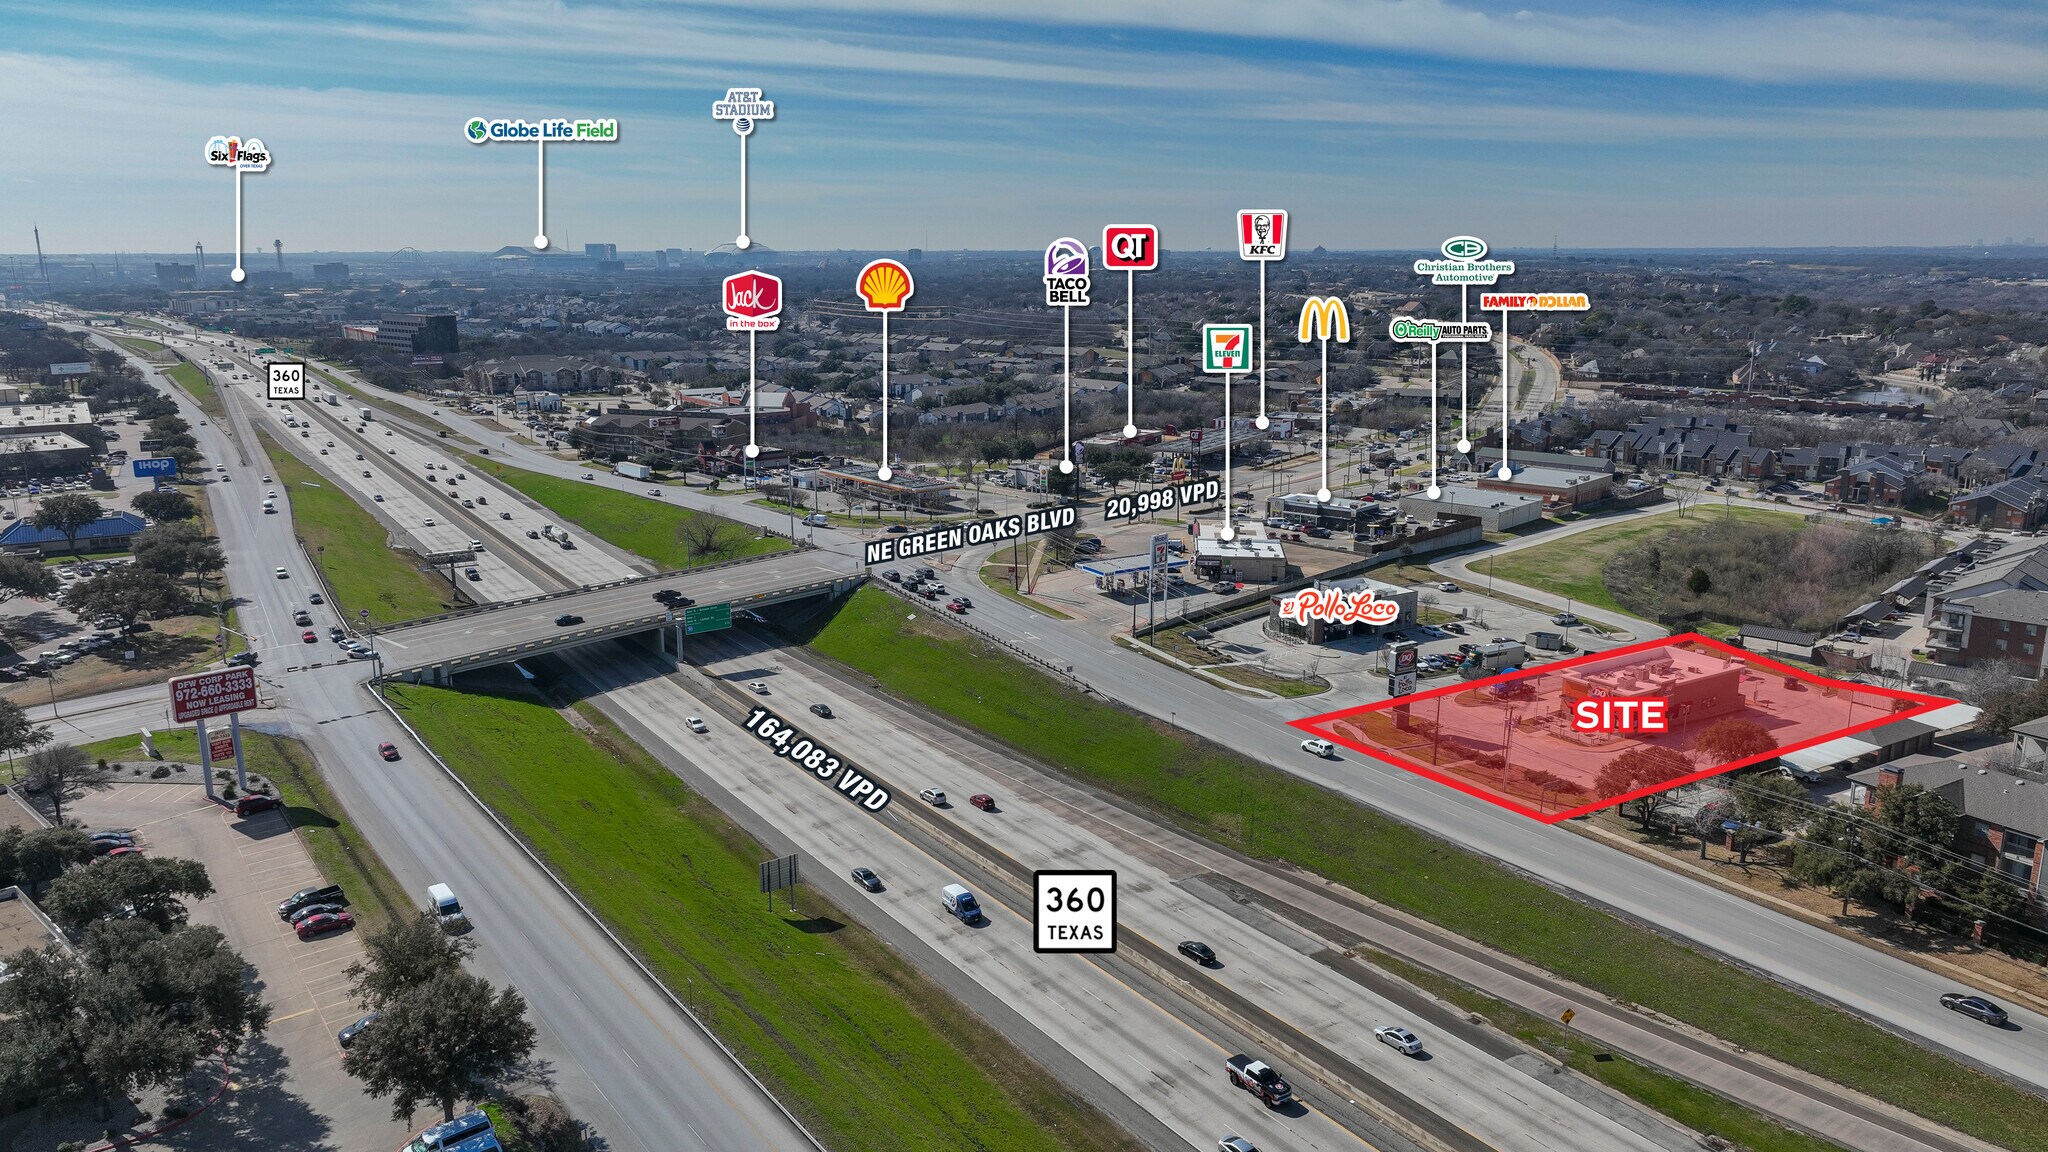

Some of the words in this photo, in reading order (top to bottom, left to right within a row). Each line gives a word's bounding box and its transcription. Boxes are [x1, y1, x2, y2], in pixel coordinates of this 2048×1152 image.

[139, 460, 169, 470] IHOP
[176, 677, 253, 702] 972-660-3333
[177, 680, 196, 690] DFW
[199, 675, 223, 685] CORP
[225, 670, 248, 680] PARK
[186, 699, 206, 710] NOW
[209, 692, 245, 705] LEASING
